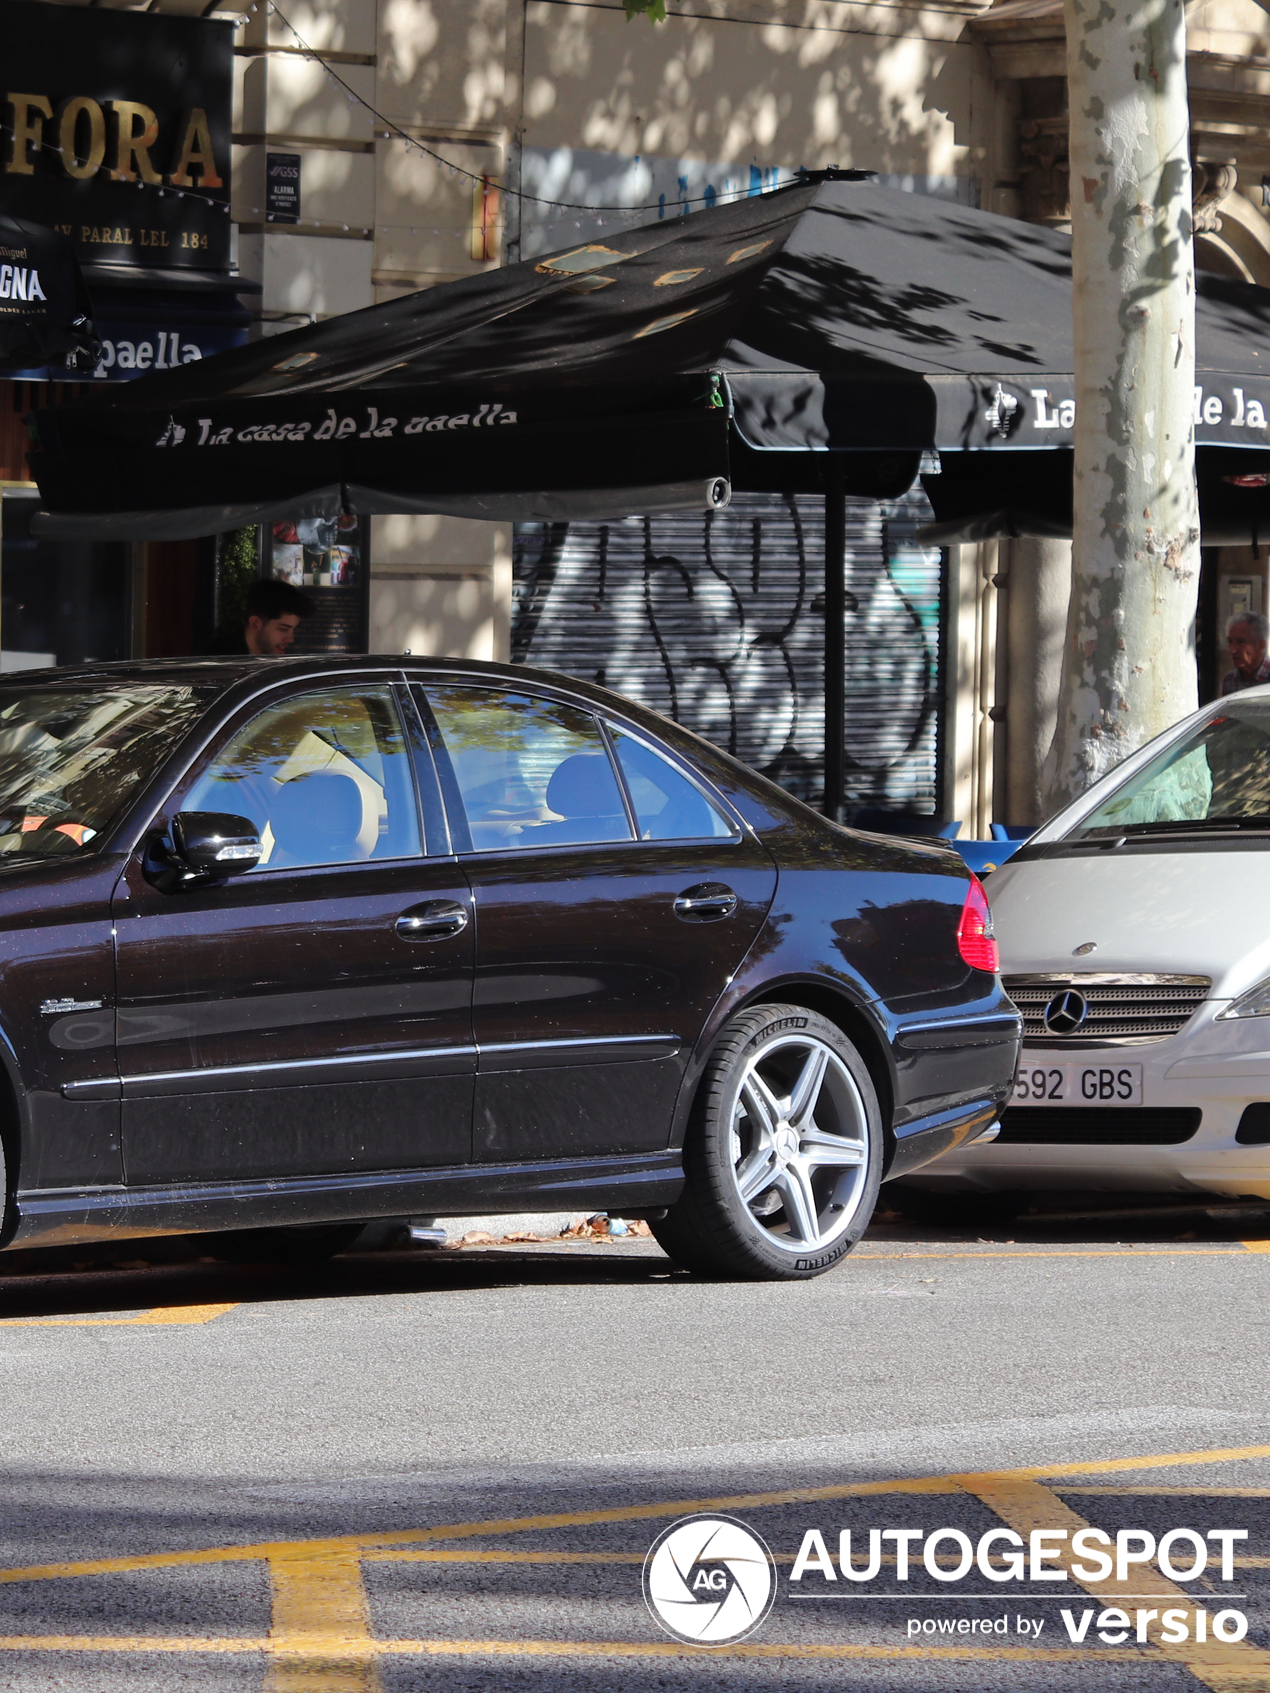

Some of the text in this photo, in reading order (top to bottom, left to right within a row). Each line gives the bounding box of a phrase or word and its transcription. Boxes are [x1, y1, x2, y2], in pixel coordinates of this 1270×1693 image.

[81, 226, 134, 245] PARAL
[140, 229, 170, 247] LEL
[181, 231, 209, 250] 184
[93, 331, 203, 378] paella
[1030, 388, 1075, 429] La
[1230, 387, 1268, 429] la
[237, 421, 311, 443] casa
[313, 408, 357, 440] de
[359, 406, 399, 439] la
[755, 1017, 807, 1045] MICHELIN
[1081, 1069, 1133, 1100] GBS
[796, 1241, 847, 1270] MICHELIN
